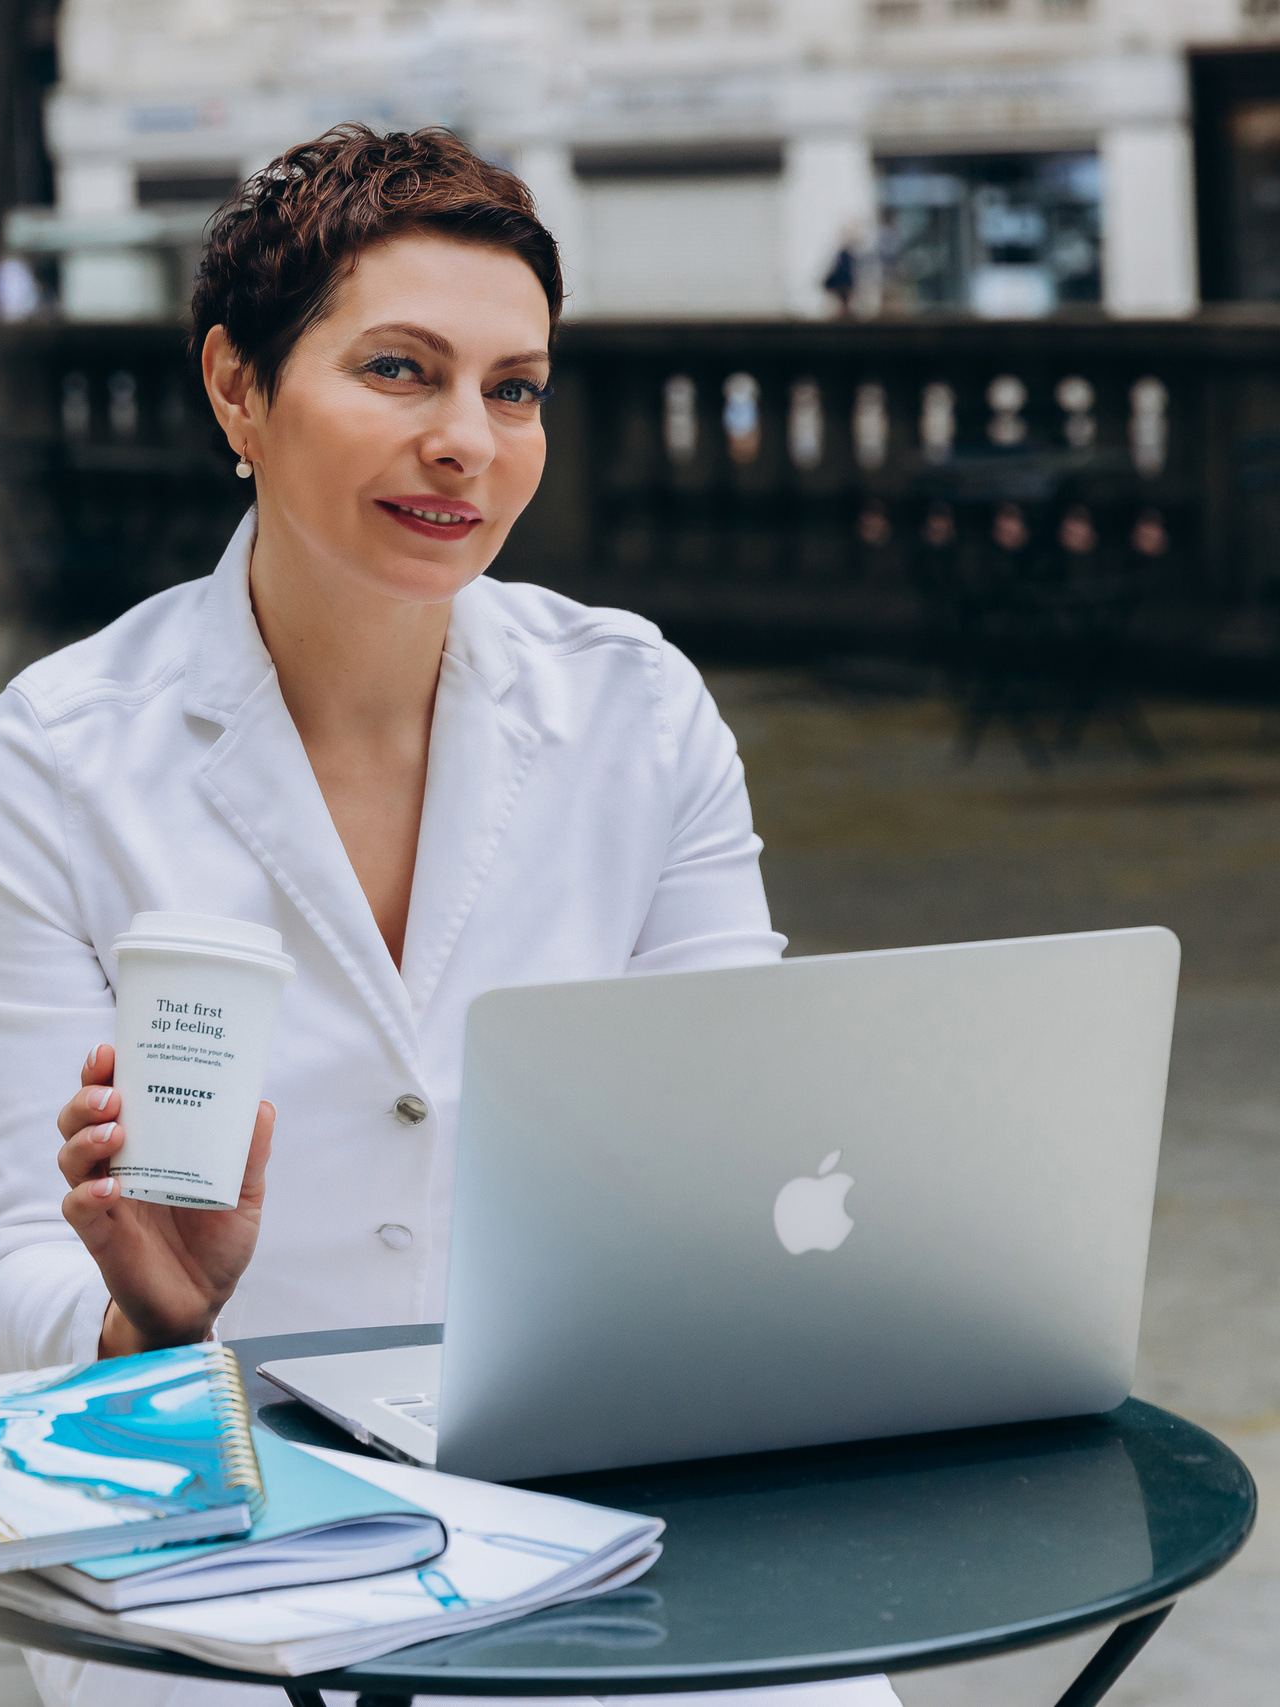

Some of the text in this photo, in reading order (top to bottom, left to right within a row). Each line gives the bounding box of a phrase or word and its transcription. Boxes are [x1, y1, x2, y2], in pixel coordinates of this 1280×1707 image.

[157, 999, 223, 1018] That first
[151, 1018, 226, 1039] sip feeling.
[188, 1046, 198, 1054] joy
[154, 1097, 202, 1108] REWARDS
